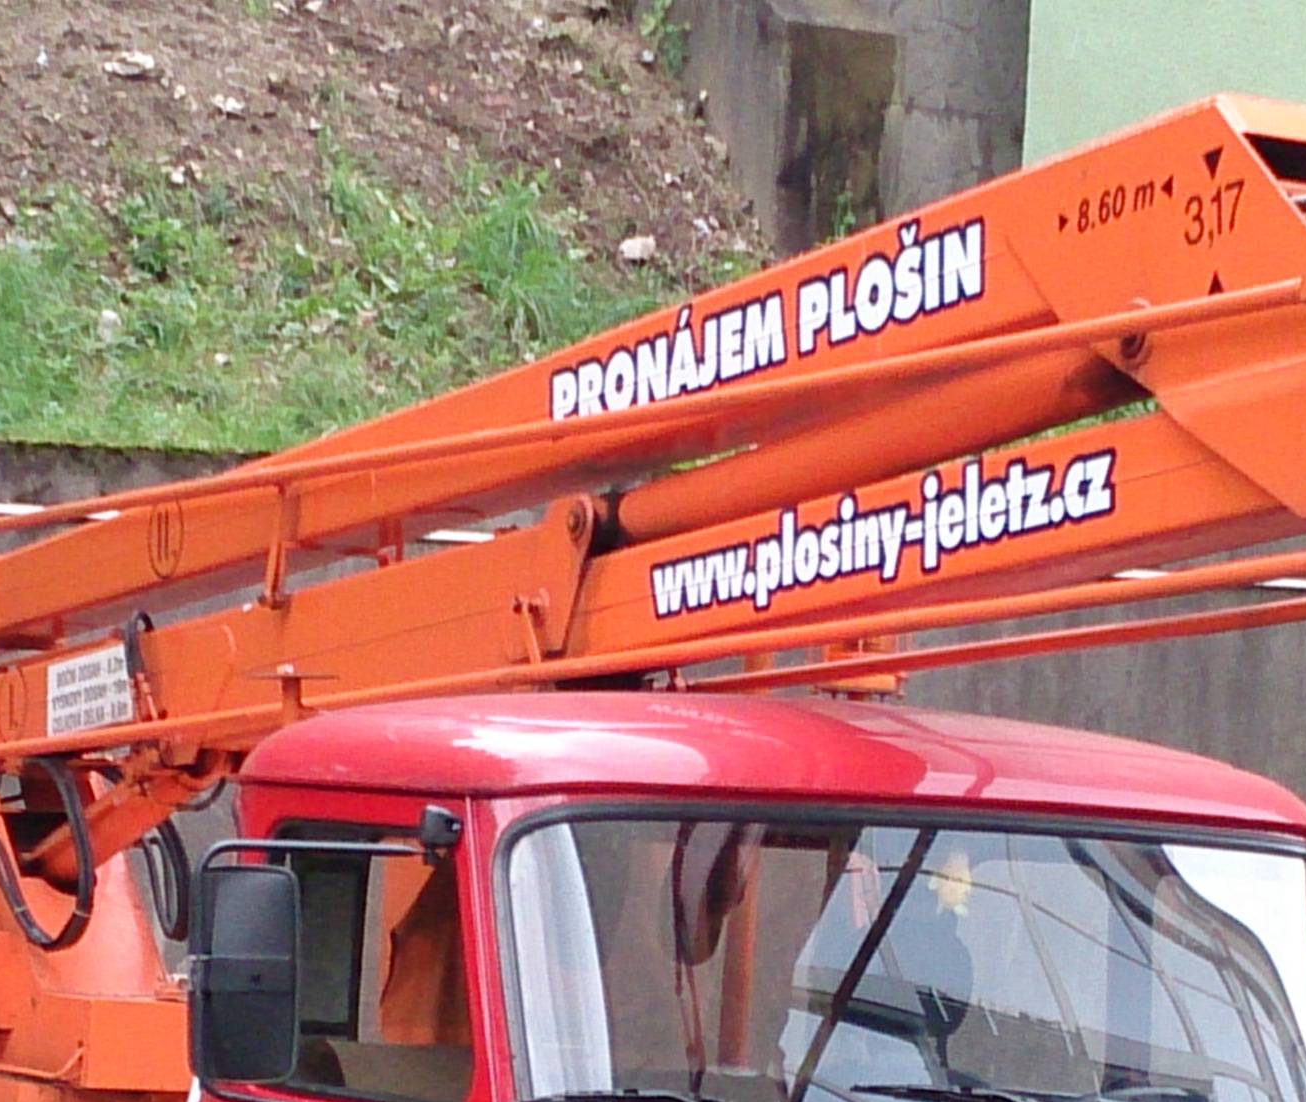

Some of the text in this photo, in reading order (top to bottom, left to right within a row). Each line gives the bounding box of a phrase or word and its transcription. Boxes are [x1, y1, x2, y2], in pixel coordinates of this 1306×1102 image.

[1077, 180, 1156, 234] 8.60 m
[1184, 179, 1245, 249] 3,17
[550, 217, 985, 421] PRONÁJEM PLOŠIN
[650, 448, 1116, 618] www.plosiny-jeletz.cz
